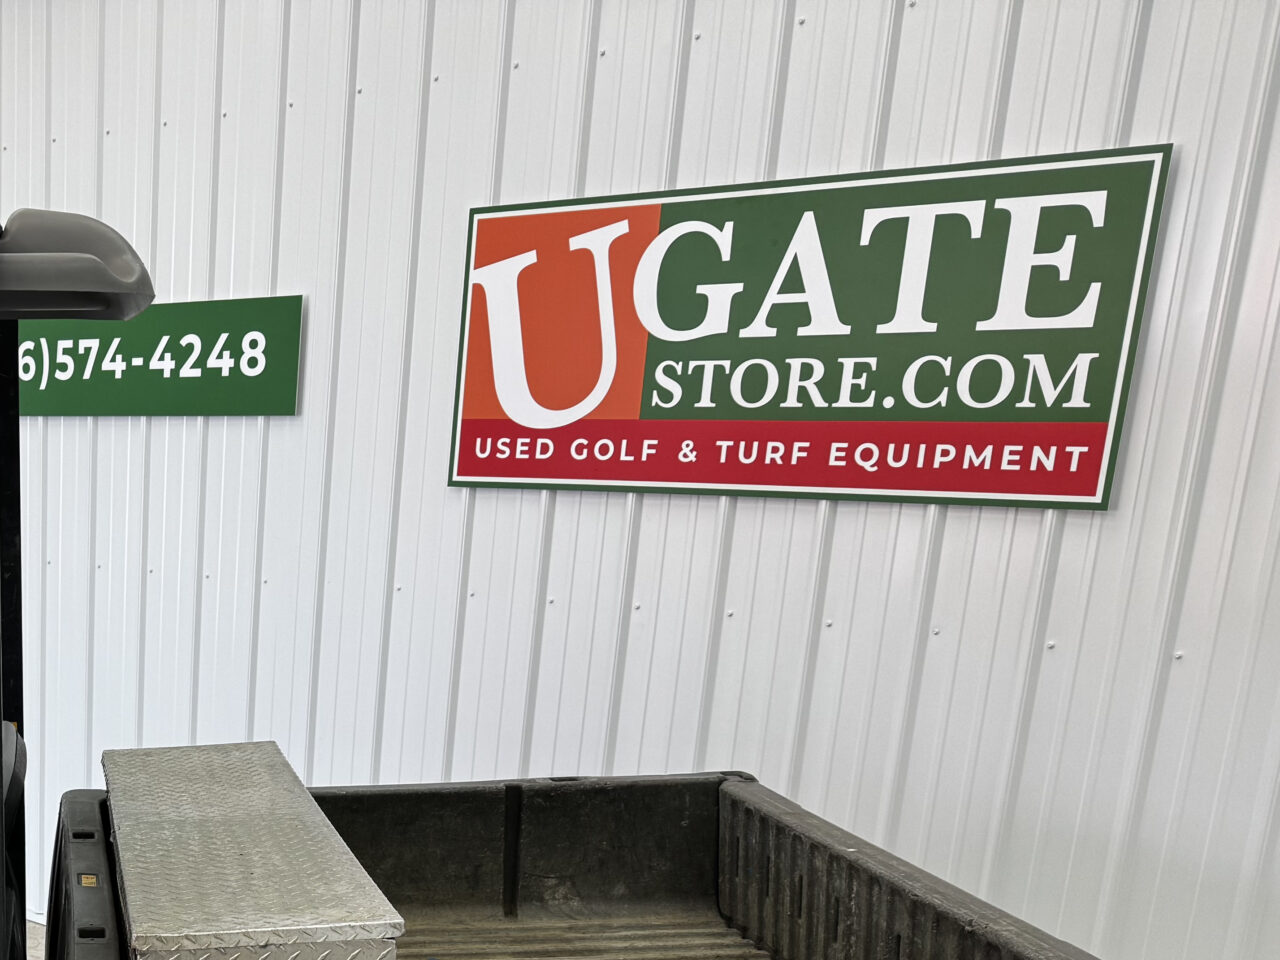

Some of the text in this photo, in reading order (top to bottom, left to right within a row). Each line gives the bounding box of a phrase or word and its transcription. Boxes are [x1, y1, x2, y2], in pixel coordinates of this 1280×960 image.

[651, 352, 1100, 409] STORE.COM
[475, 437, 1089, 473] USED GOLF & TURF EQUIPMENT
